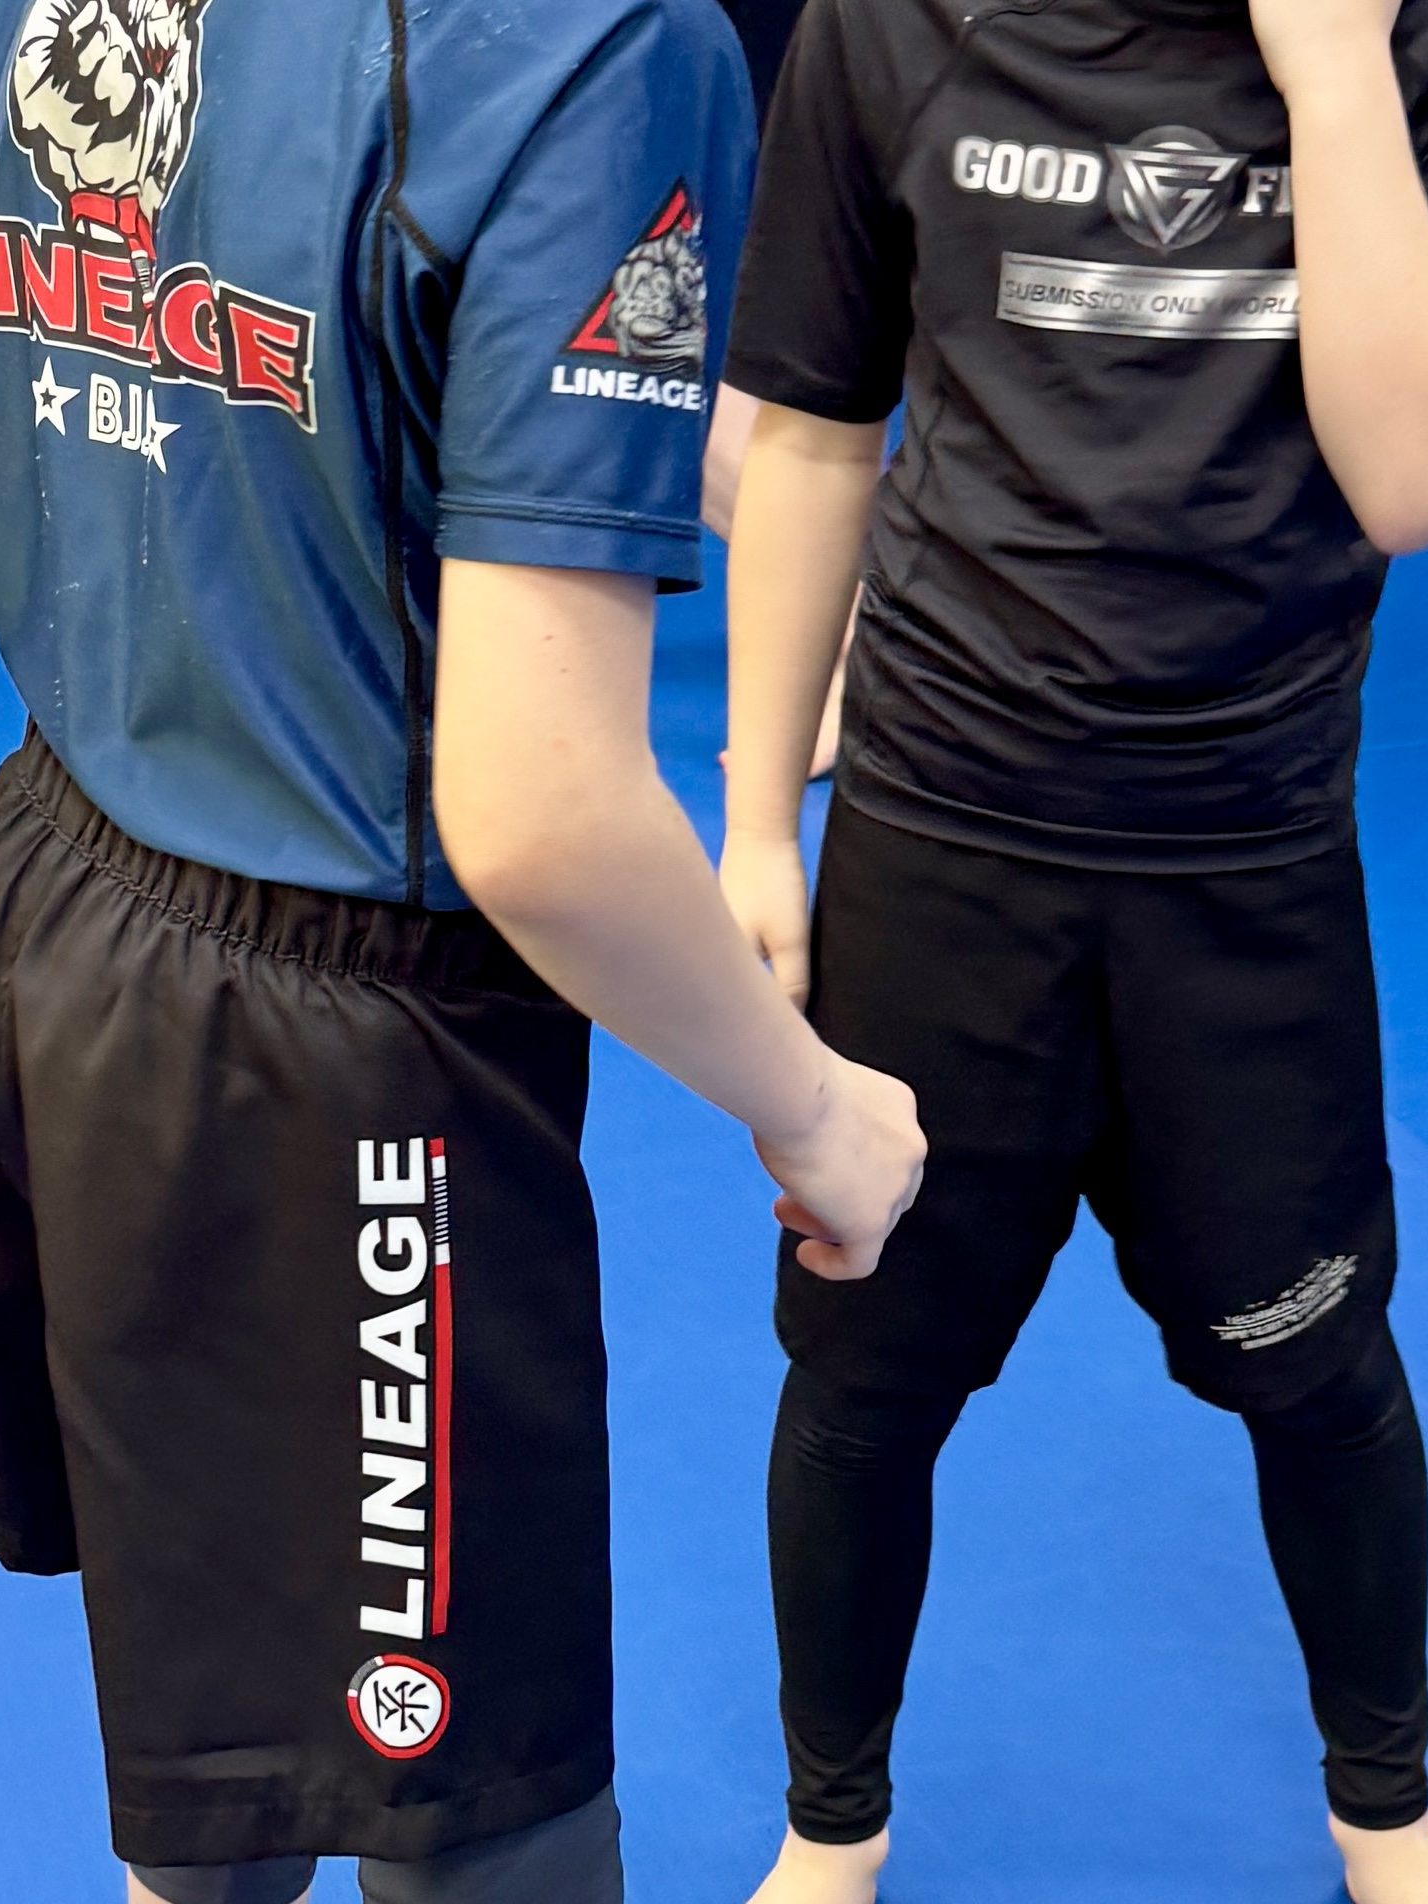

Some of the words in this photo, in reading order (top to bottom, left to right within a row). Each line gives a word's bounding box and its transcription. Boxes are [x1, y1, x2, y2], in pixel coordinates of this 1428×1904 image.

[953, 136, 1103, 205] GOOD
[1004, 280, 1144, 312] SUBMISSION
[551, 364, 703, 411] LINEAGE
[357, 1137, 427, 1640] LINEAGE
